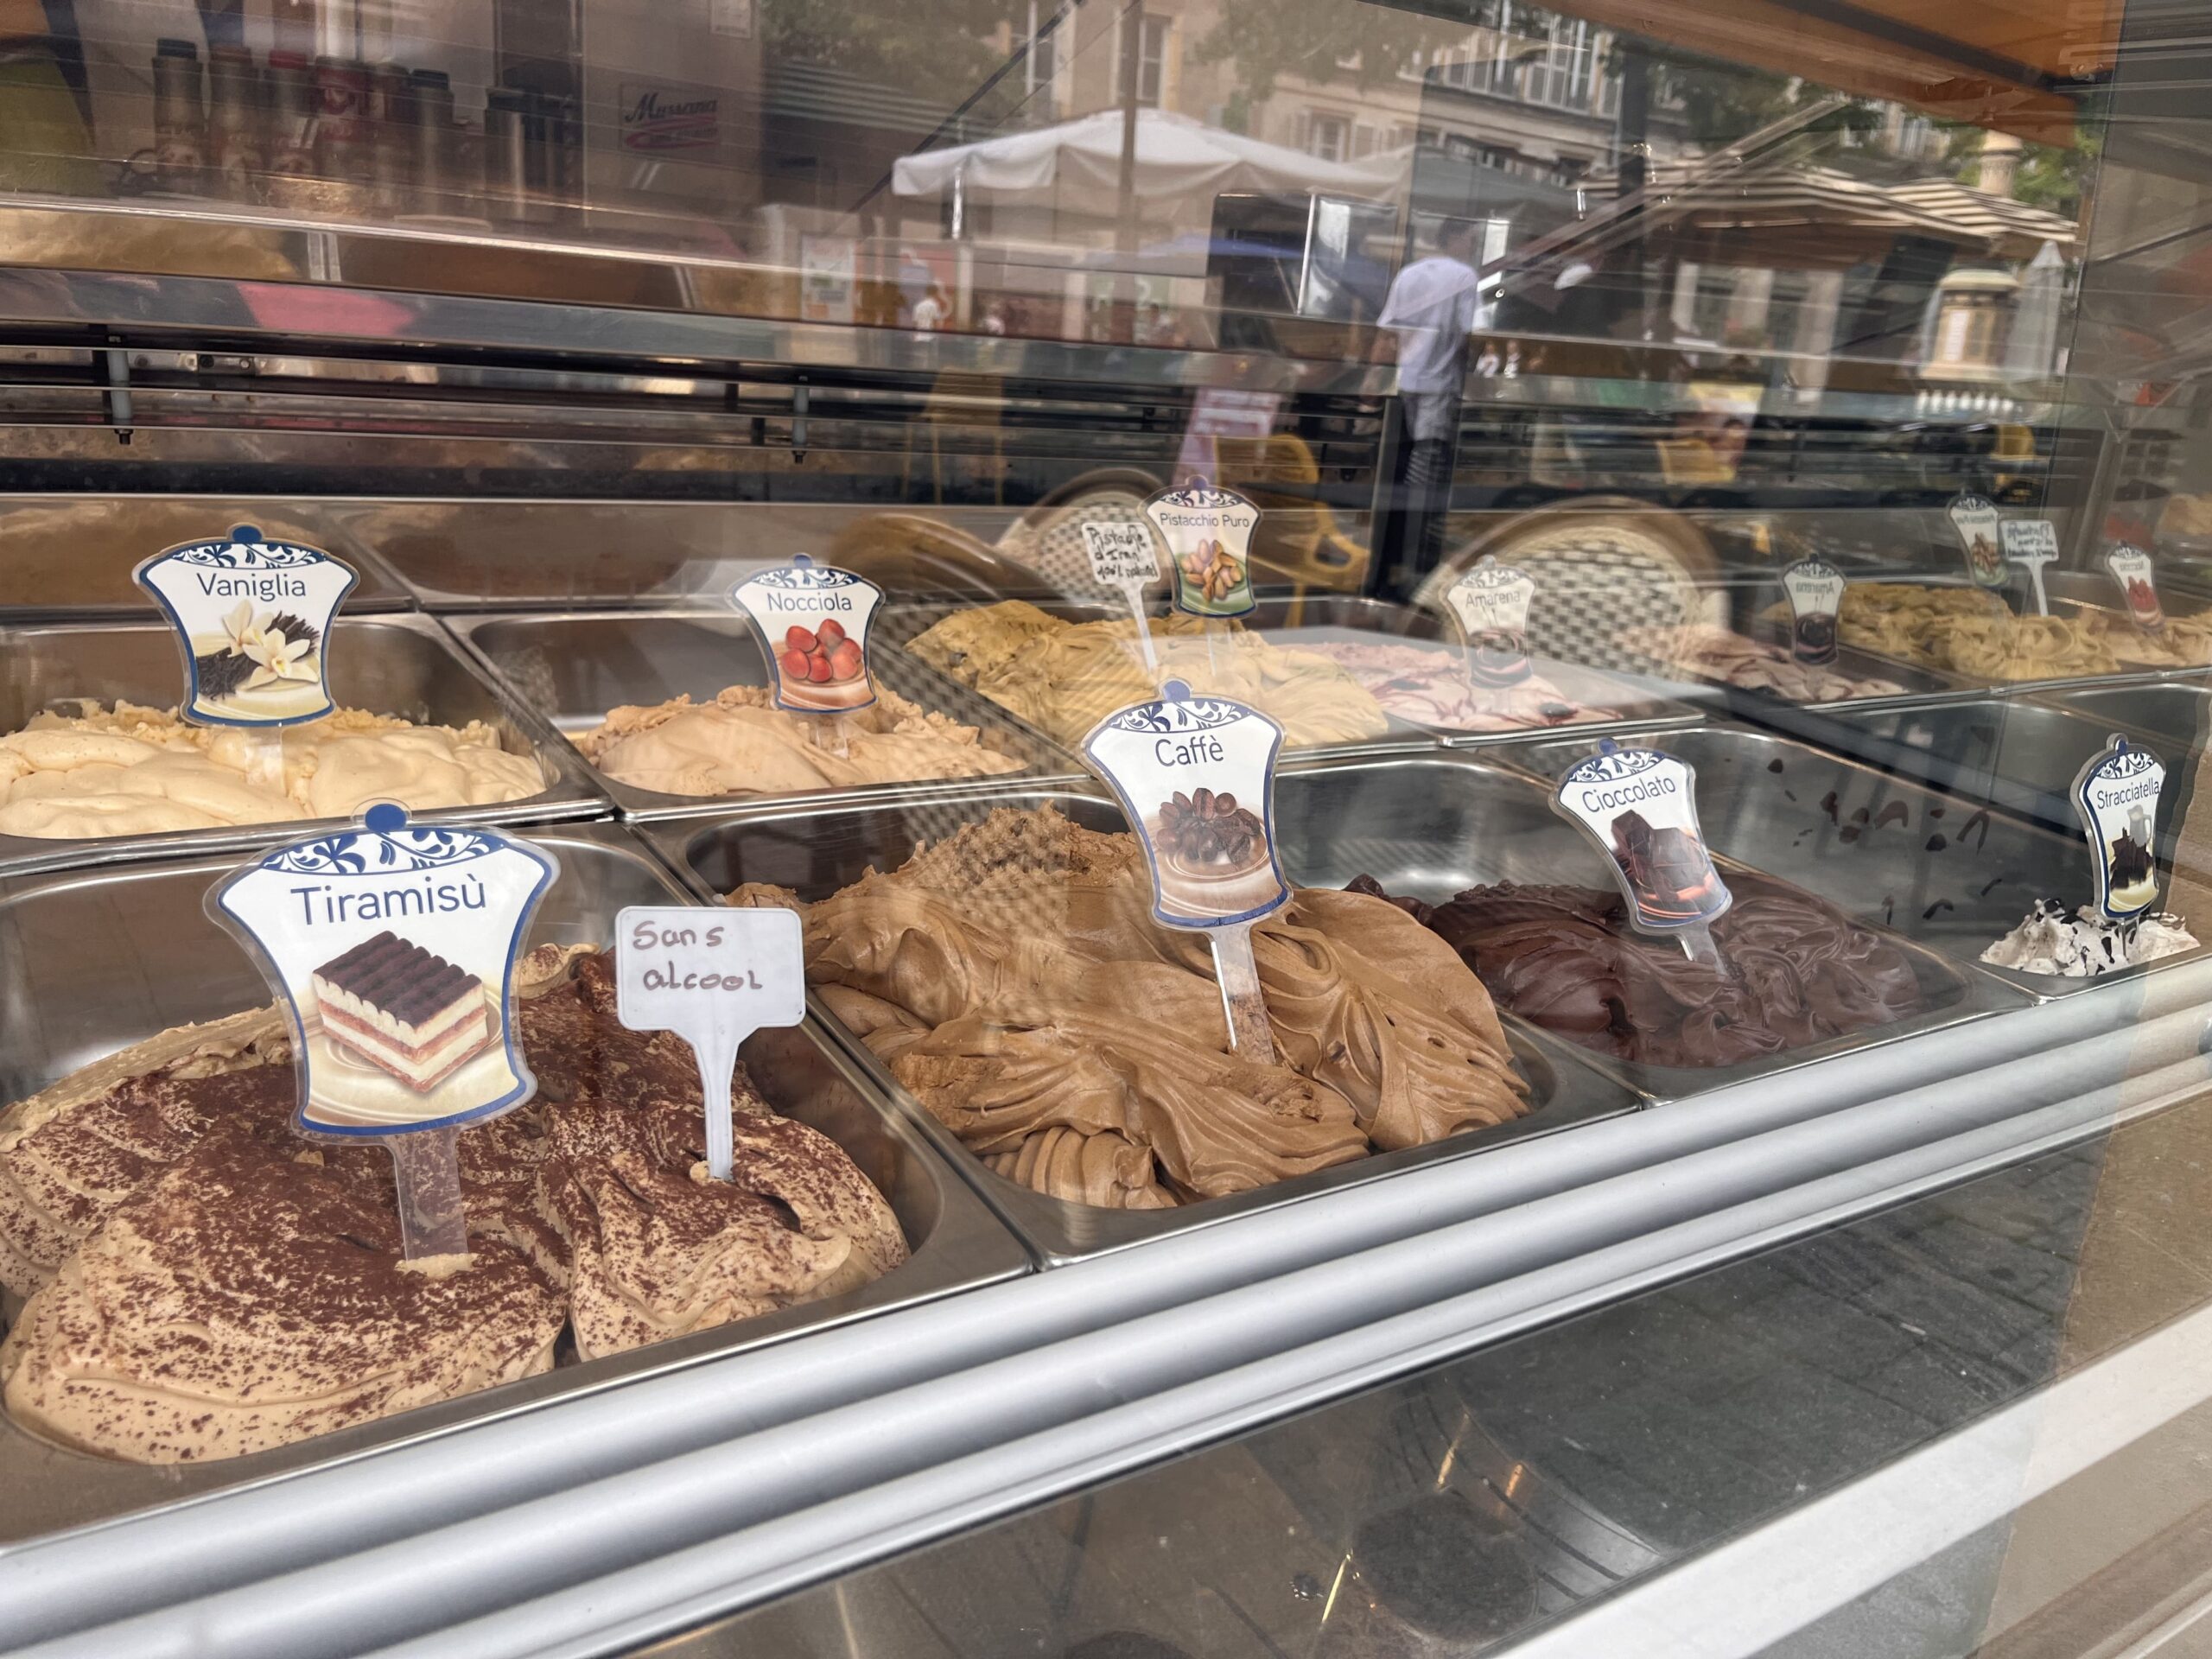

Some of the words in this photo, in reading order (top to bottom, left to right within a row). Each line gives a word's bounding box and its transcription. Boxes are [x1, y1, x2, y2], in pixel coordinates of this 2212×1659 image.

[1160, 512, 1219, 528] Pistacchio
[1222, 514, 1249, 528] Puro
[196, 572, 306, 602] Vaniglia
[766, 592, 853, 612] Nocciola
[1465, 590, 1522, 607] Amarena
[1154, 734, 1224, 767] Caffè
[1581, 775, 1676, 813] Cioccolato
[2096, 778, 2160, 810] Stracciatella
[290, 873, 487, 925] Tiramisù
[632, 920, 725, 950] Sans
[643, 960, 763, 991] alcool
